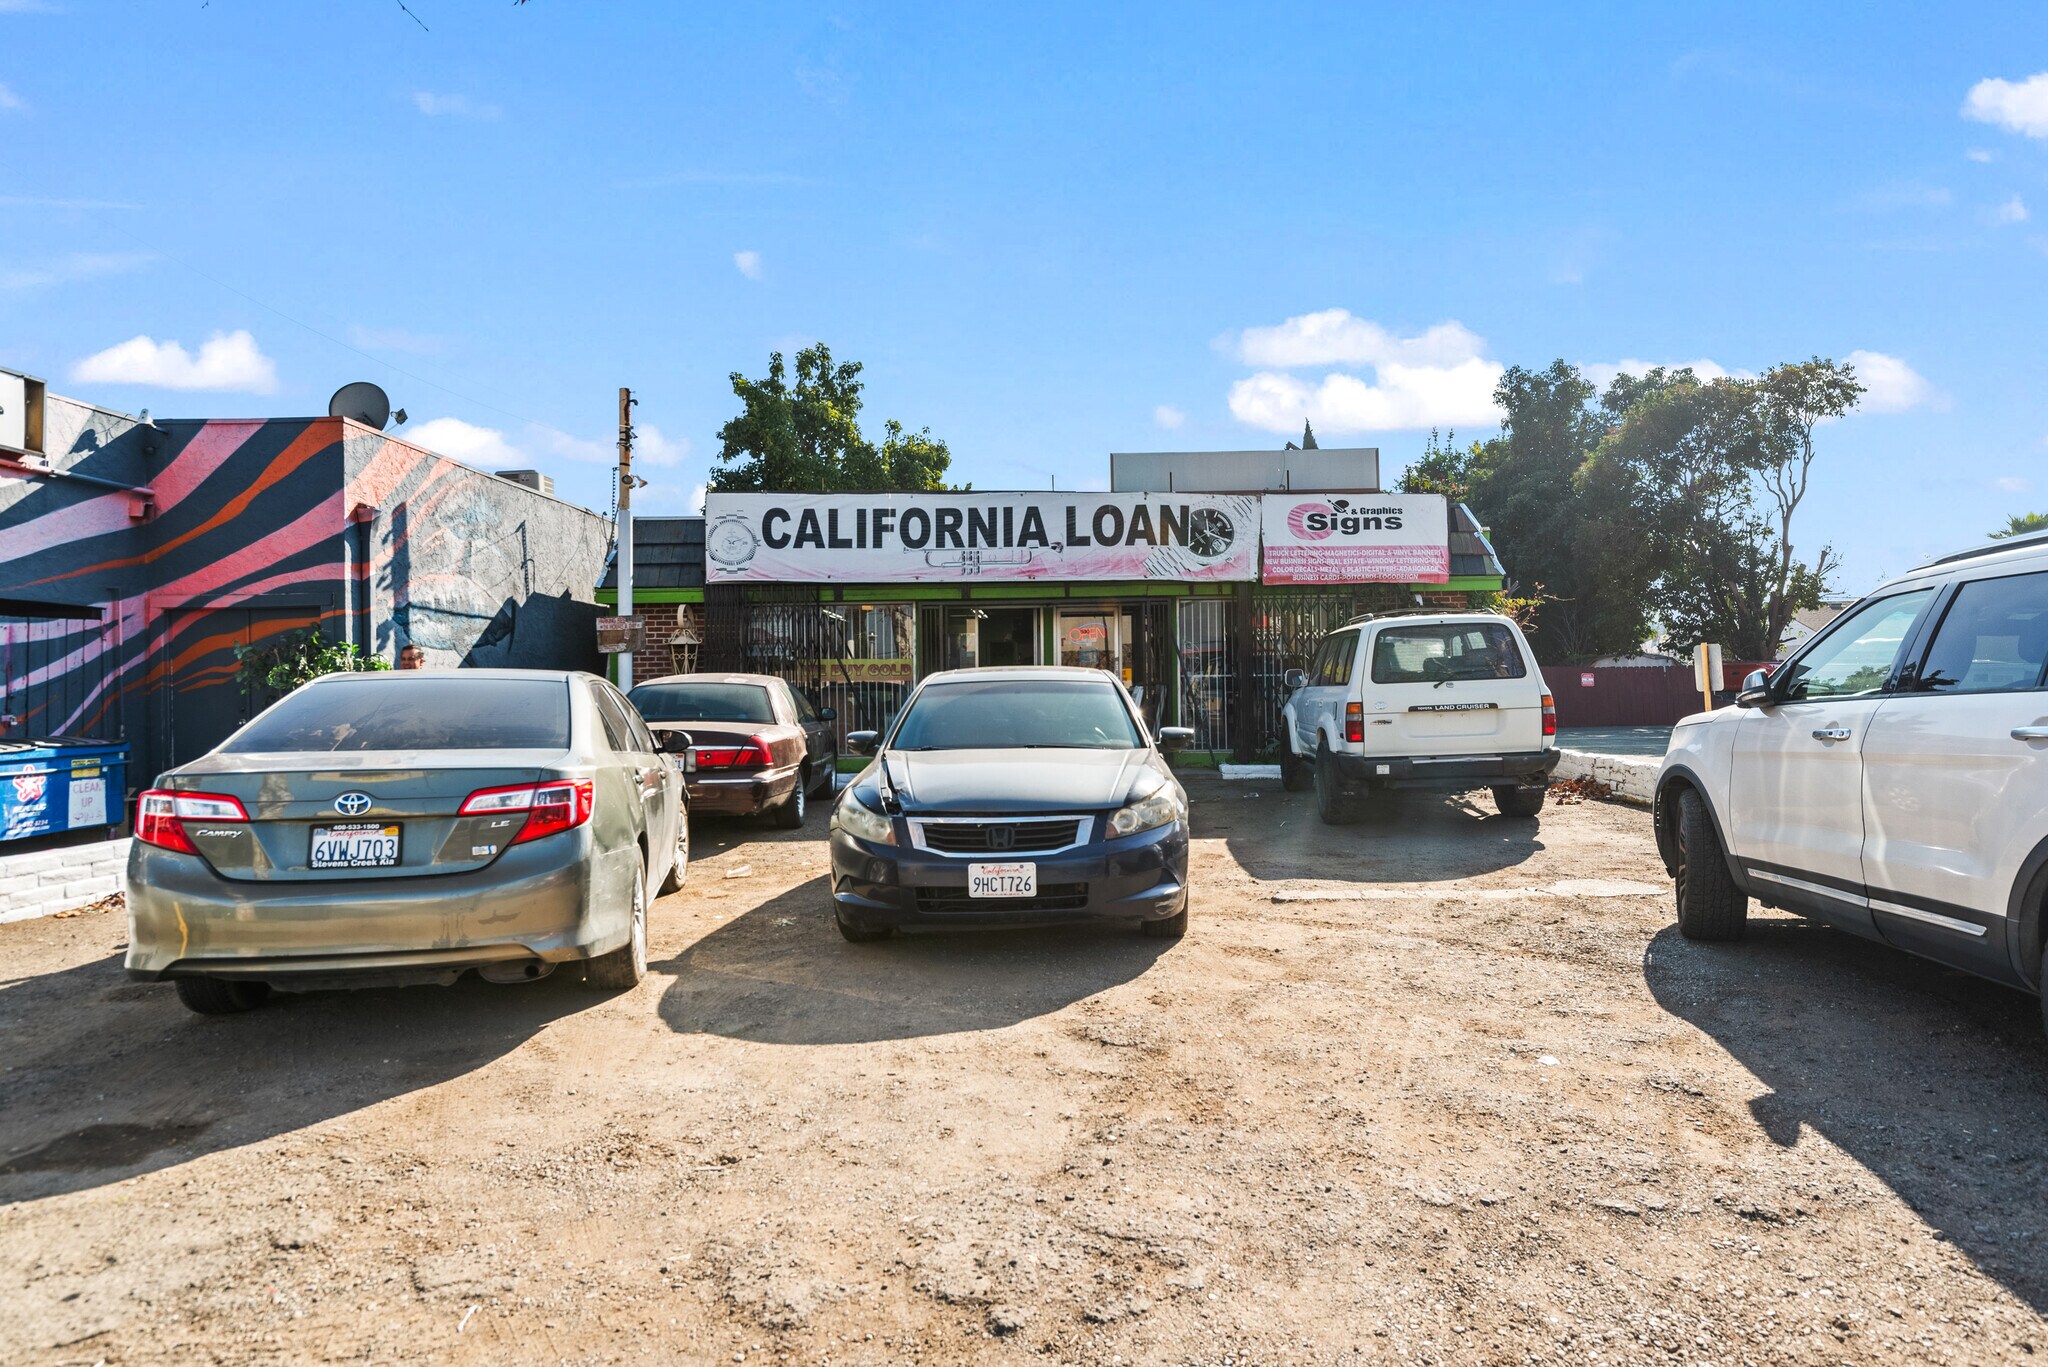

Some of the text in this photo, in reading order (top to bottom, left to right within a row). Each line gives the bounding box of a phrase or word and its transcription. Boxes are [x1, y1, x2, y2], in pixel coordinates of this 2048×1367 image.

[1360, 507, 1403, 515] Graphics
[761, 504, 1190, 550] CALIFORNIA LOAN
[1307, 513, 1403, 535] Signs
[1069, 626, 1107, 640] OPEN
[830, 664, 864, 676] BUY
[868, 663, 912, 676] GOLD
[72, 782, 102, 794] CLEAN
[81, 797, 93, 808] UP
[490, 820, 510, 828] LE
[196, 829, 242, 838] CAMRY
[315, 839, 396, 861] 6VWJ703
[312, 860, 348, 868] Stevens
[350, 859, 377, 867] Creek
[973, 876, 1032, 893] 9HCT726
